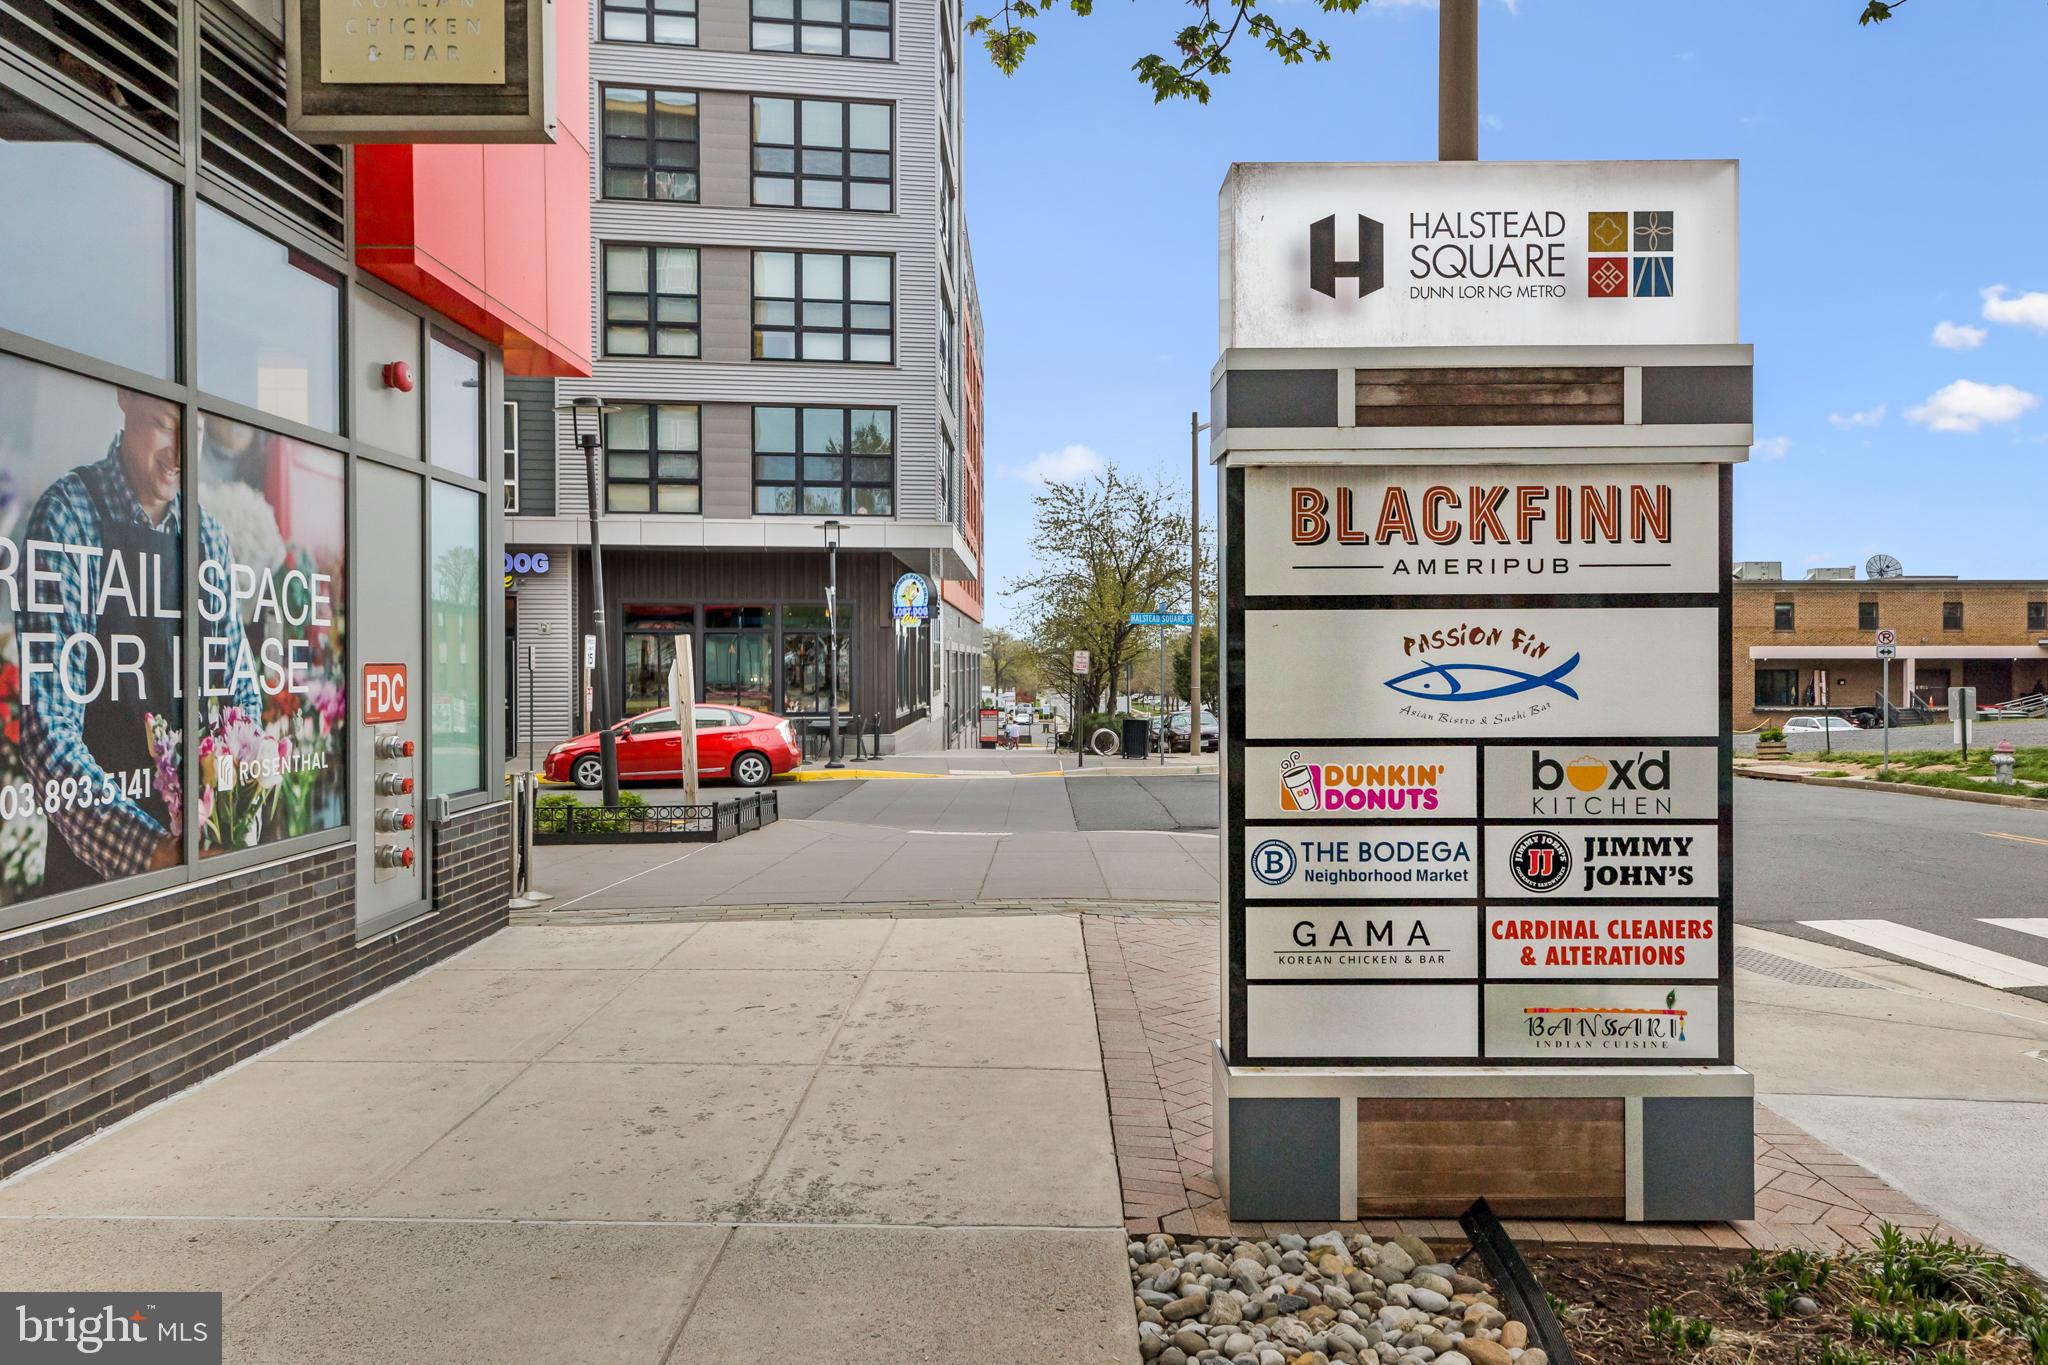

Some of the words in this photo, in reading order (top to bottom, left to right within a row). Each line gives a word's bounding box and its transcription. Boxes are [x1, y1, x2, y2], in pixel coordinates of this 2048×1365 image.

[346, 18, 481, 35] CHICKEN
[368, 45, 383, 62] &
[403, 45, 459, 61] BAR
[1409, 210, 1566, 239] HALSTEAD
[1409, 243, 1566, 280] SQUARE
[1410, 285, 1454, 299] DUNN
[1458, 285, 1513, 299] LORNG
[1516, 284, 1566, 298] METRO
[1291, 483, 1672, 546] BLACKFINN
[1393, 558, 1569, 575] AMERIPUB
[198, 559, 332, 627] SPACE
[1131, 614, 1160, 623] HALSTEAD
[1161, 614, 1184, 623] SQUARE
[1186, 615, 1193, 623] ST
[21, 631, 147, 706] FOR
[173, 635, 309, 698] LEASE
[366, 672, 405, 714] FDC
[1400, 705, 1433, 721] Asian
[1438, 713, 1475, 725] Bistro
[1480, 716, 1488, 725] &
[1493, 711, 1526, 725] Sushi
[1529, 702, 1551, 716] Bar
[240, 752, 328, 781] ROSENTHAL
[1325, 765, 1445, 787] DUNKIN'
[1325, 788, 1438, 810] DONUTS
[1533, 797, 1671, 815] KITCHEN
[1301, 842, 1349, 862] THE
[1359, 841, 1471, 862] BODEGA
[1515, 836, 1539, 862] JIMMY
[1584, 836, 1694, 858] JIMMY
[1264, 850, 1284, 874] B
[1528, 849, 1554, 876] JJ
[1304, 868, 1412, 885] Neighborhood
[1416, 868, 1469, 882] Market
[1584, 865, 1694, 891] JOHN'S
[1293, 920, 1430, 947] GAMA
[1491, 919, 1600, 940] CARDINAL
[1607, 919, 1713, 940] CLEANERS
[1278, 955, 1332, 965] KOREAN
[1339, 955, 1397, 964] CHICKEN
[1404, 955, 1412, 964] &
[1419, 955, 1445, 964] BAR
[1520, 945, 1537, 966] &
[1545, 945, 1685, 966] ALTERATIONS
[1536, 1040, 1592, 1049] INDIAN
[1602, 1040, 1668, 1049] CUISINE
